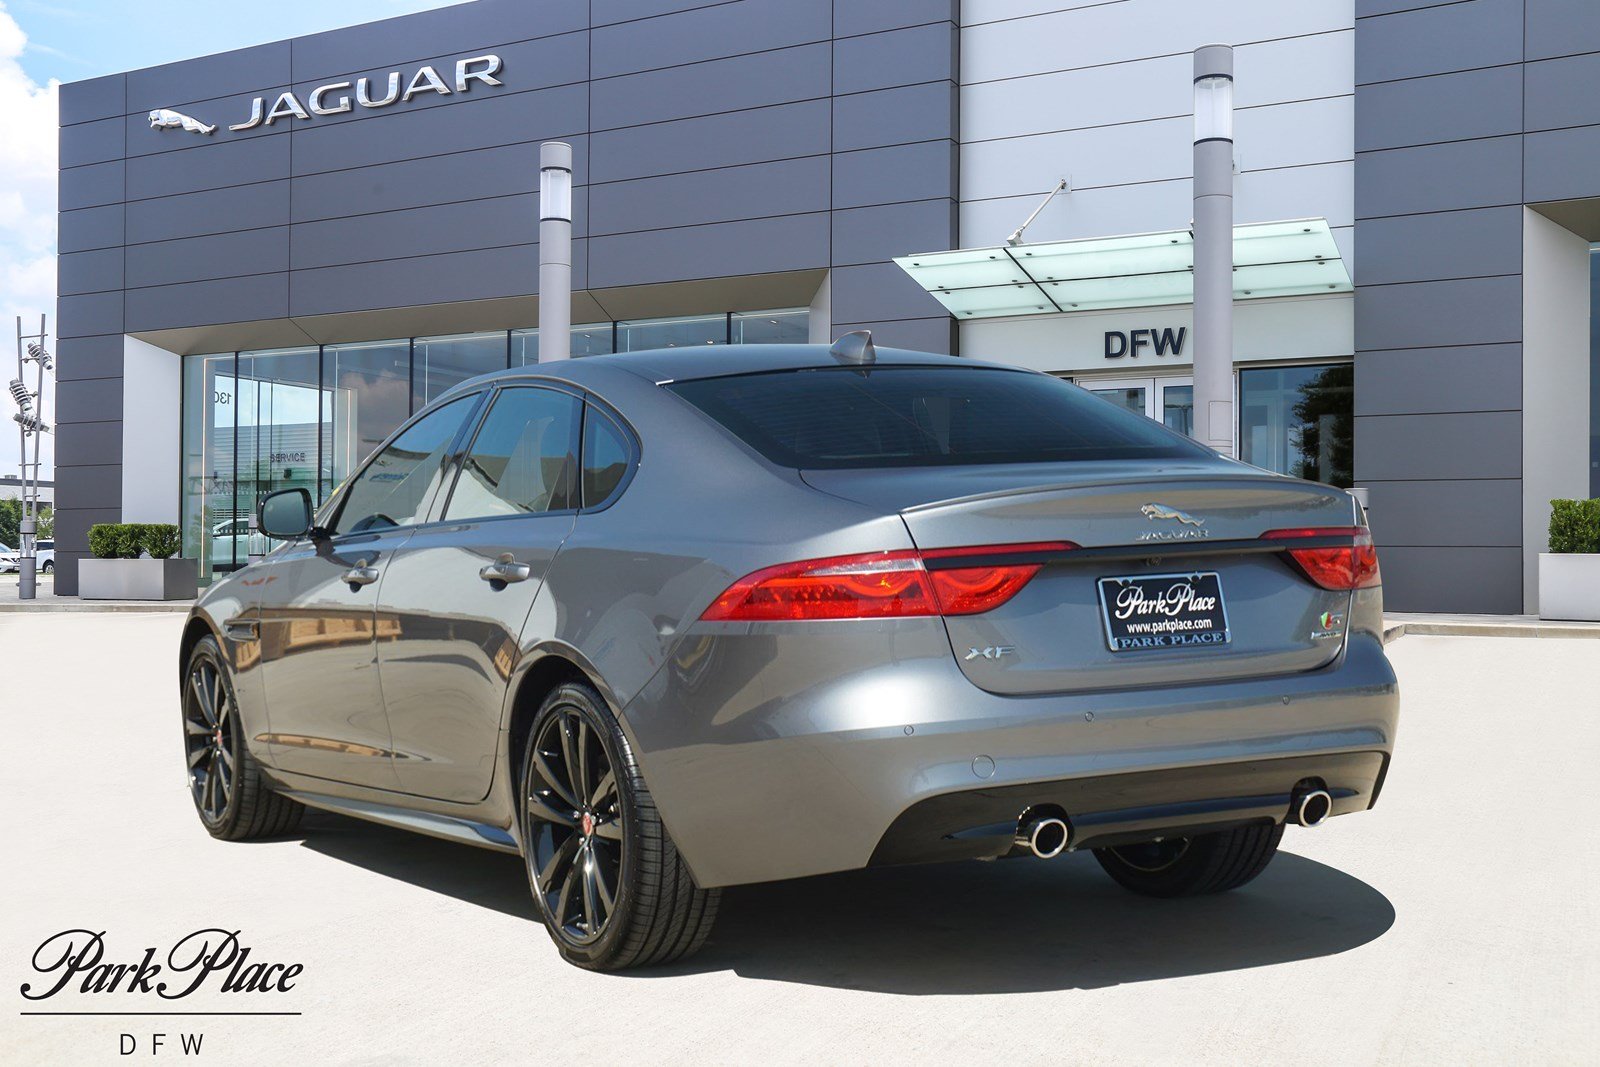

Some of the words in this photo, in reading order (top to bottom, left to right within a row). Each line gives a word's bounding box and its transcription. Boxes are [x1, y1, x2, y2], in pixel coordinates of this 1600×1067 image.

[228, 54, 503, 132] JAGUAR
[1104, 326, 1188, 359] DFW
[1115, 586, 1167, 619] Park
[1164, 583, 1216, 616] Place
[1127, 618, 1212, 634] www.parkplace.com
[1121, 637, 1165, 648] PARK
[1171, 633, 1222, 644] PLACE
[964, 646, 1015, 660] XF
